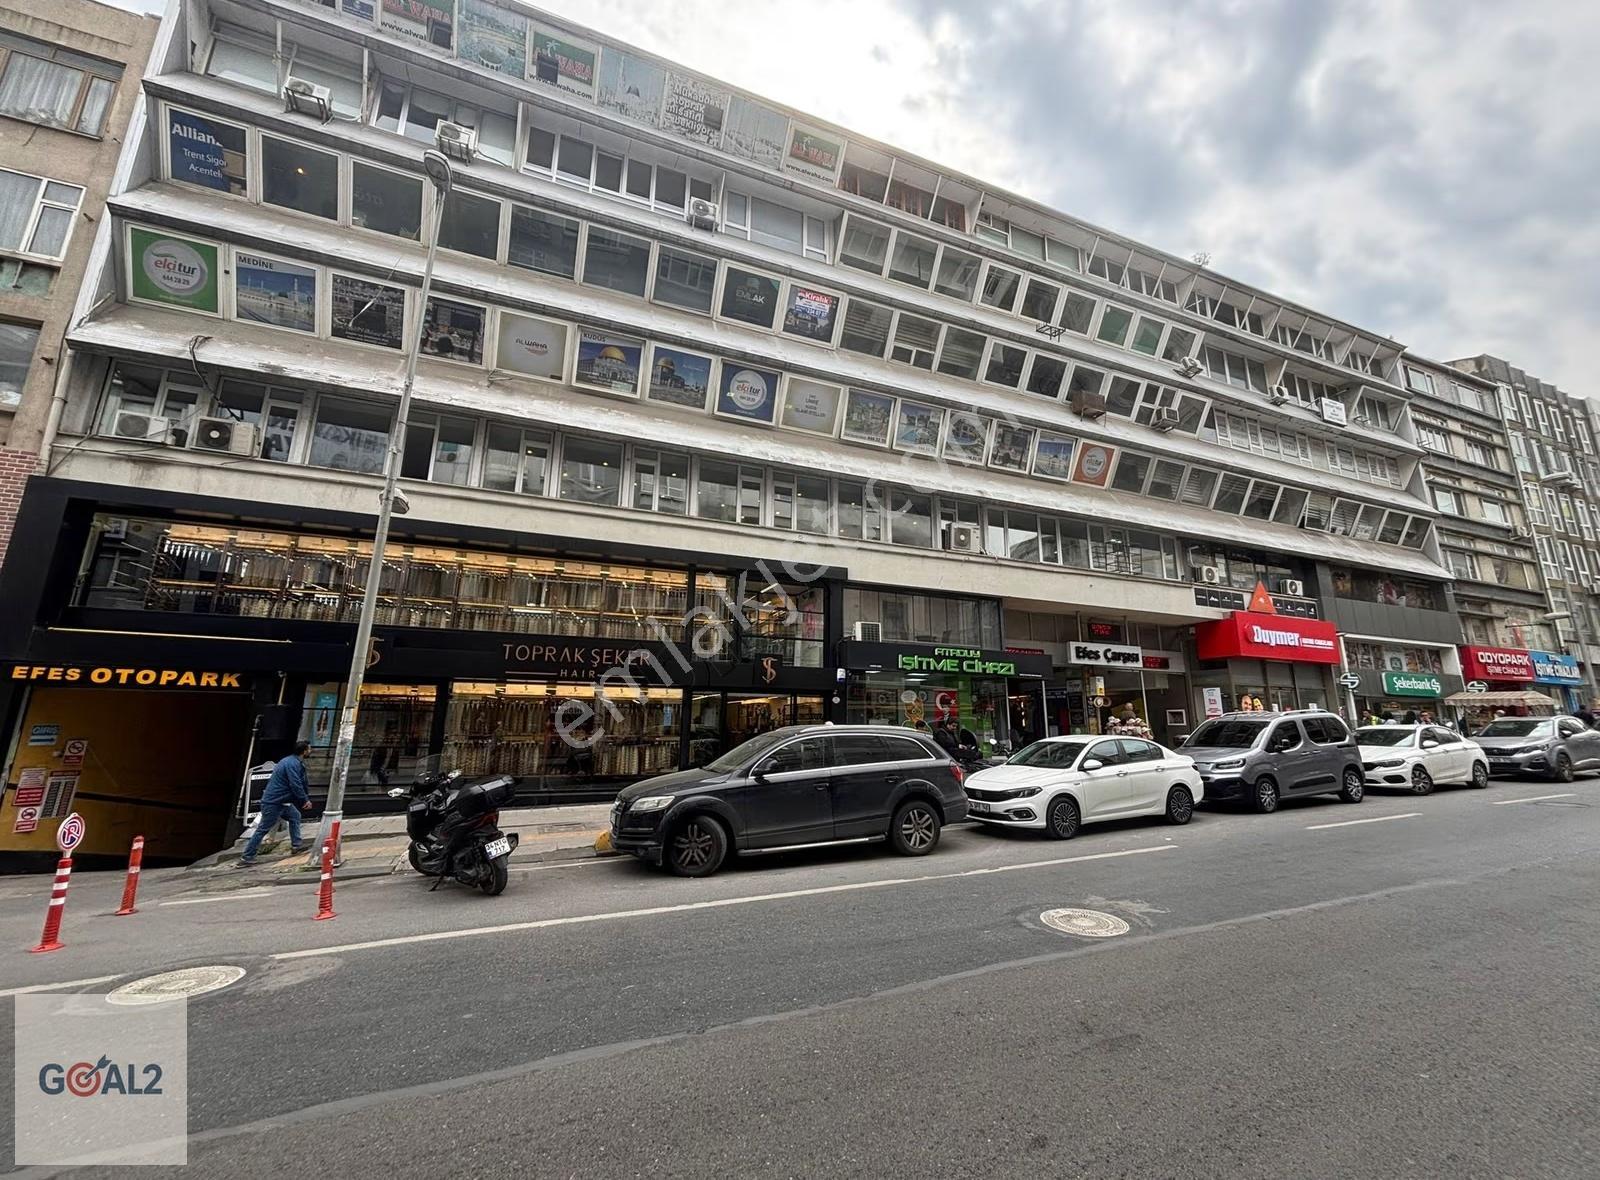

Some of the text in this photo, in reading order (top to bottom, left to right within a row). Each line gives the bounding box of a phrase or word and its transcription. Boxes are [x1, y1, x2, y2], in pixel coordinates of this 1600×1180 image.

[172, 123, 223, 148] Allian
[183, 148, 205, 160] Trent
[1252, 625, 1300, 647] Duymer
[503, 643, 651, 668] TOPRAK ŞEKER
[1075, 646, 1101, 660] Efes
[1478, 652, 1531, 666] ODYOPARK
[11, 665, 242, 688] EFES OTOPARK
[559, 669, 596, 678] HAIR
[1393, 676, 1432, 692] Şekerbank
